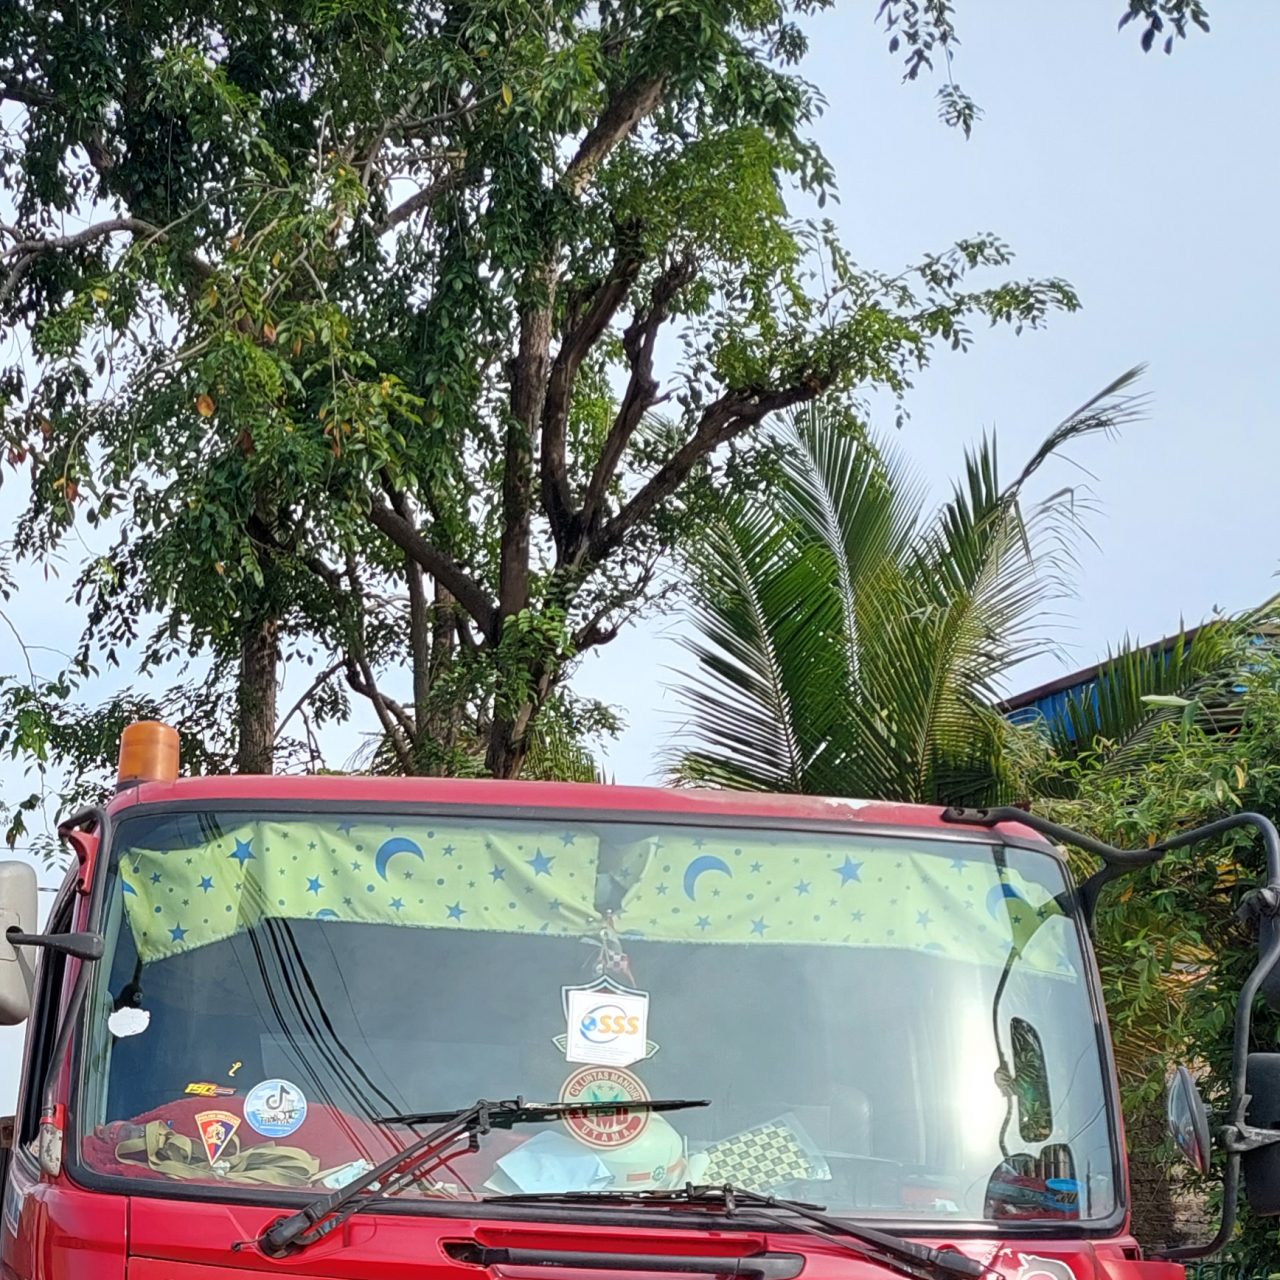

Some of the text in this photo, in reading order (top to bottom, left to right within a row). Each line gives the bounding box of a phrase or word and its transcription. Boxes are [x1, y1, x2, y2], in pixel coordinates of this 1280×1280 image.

[598, 1014, 640, 1036] SSS
[580, 1071, 610, 1090] LINTAS
[610, 1072, 642, 1102] MANDIRI
